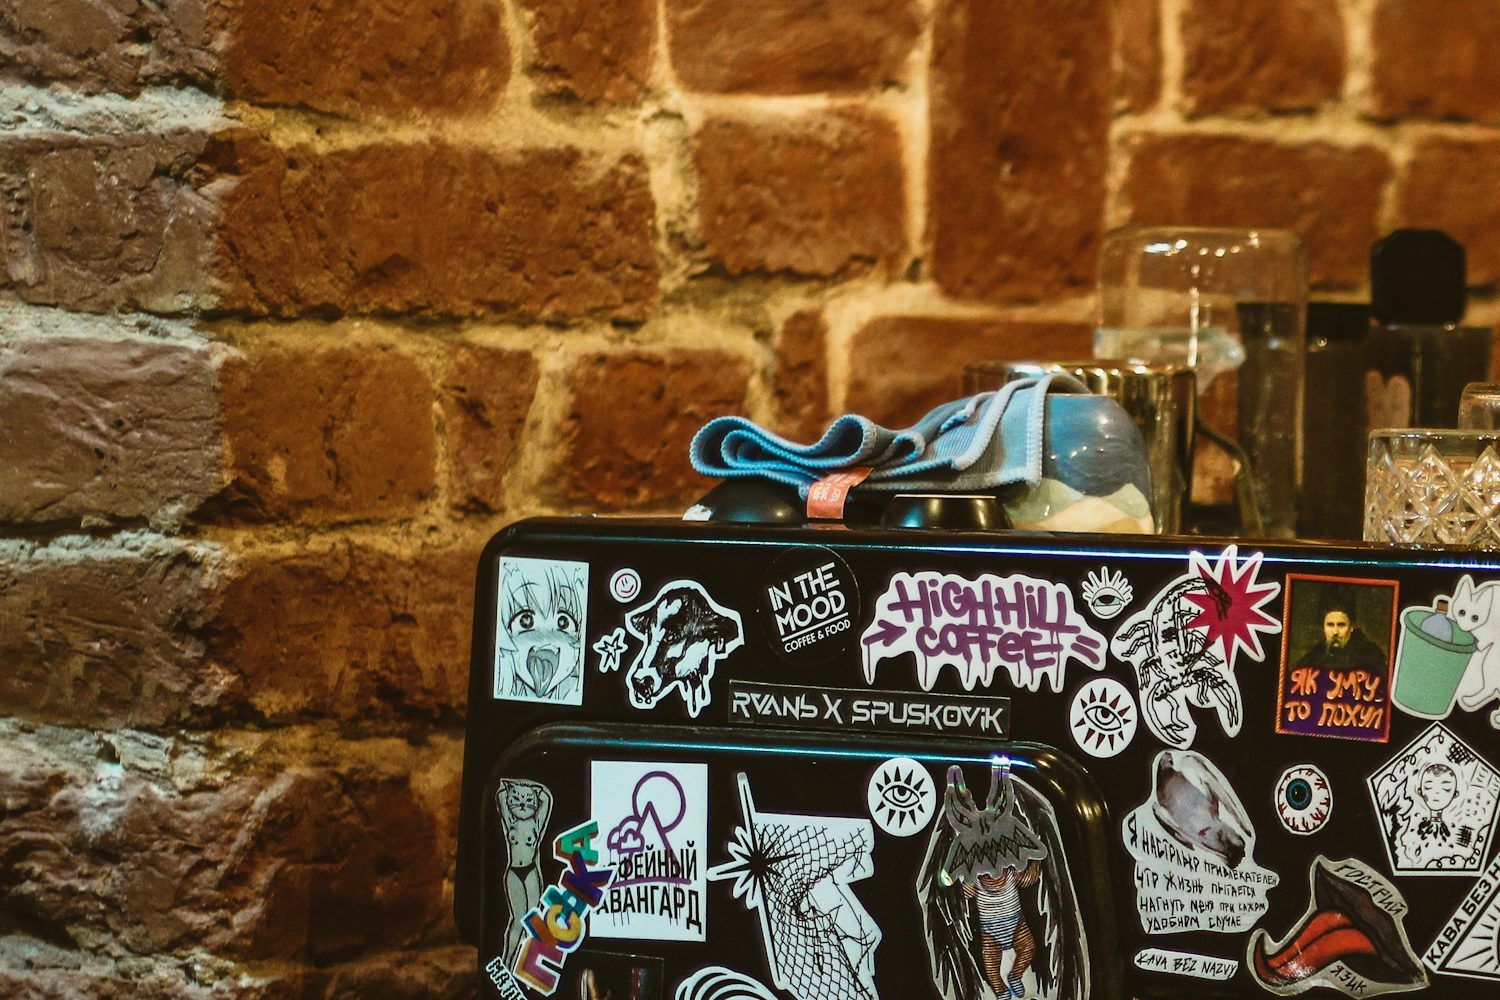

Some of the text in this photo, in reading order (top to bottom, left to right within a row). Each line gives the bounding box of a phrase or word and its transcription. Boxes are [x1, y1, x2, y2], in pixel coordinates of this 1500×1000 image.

[768, 562, 840, 608] IN THE
[775, 590, 846, 636] MOOD
[784, 630, 818, 653] COFFEE
[825, 620, 851, 639] FOOD
[1290, 668, 1320, 696] ЯК
[1284, 701, 1311, 722] ТО
[1127, 812, 1138, 848] Я
[1163, 871, 1204, 894] ЖИЗНЬ
[1334, 864, 1404, 917] ГОСТРИЙ
[1426, 919, 1468, 966] КАВА
[1464, 879, 1492, 917] БЕЗ
[1136, 952, 1237, 978] KAVA BEZ NAZVY
